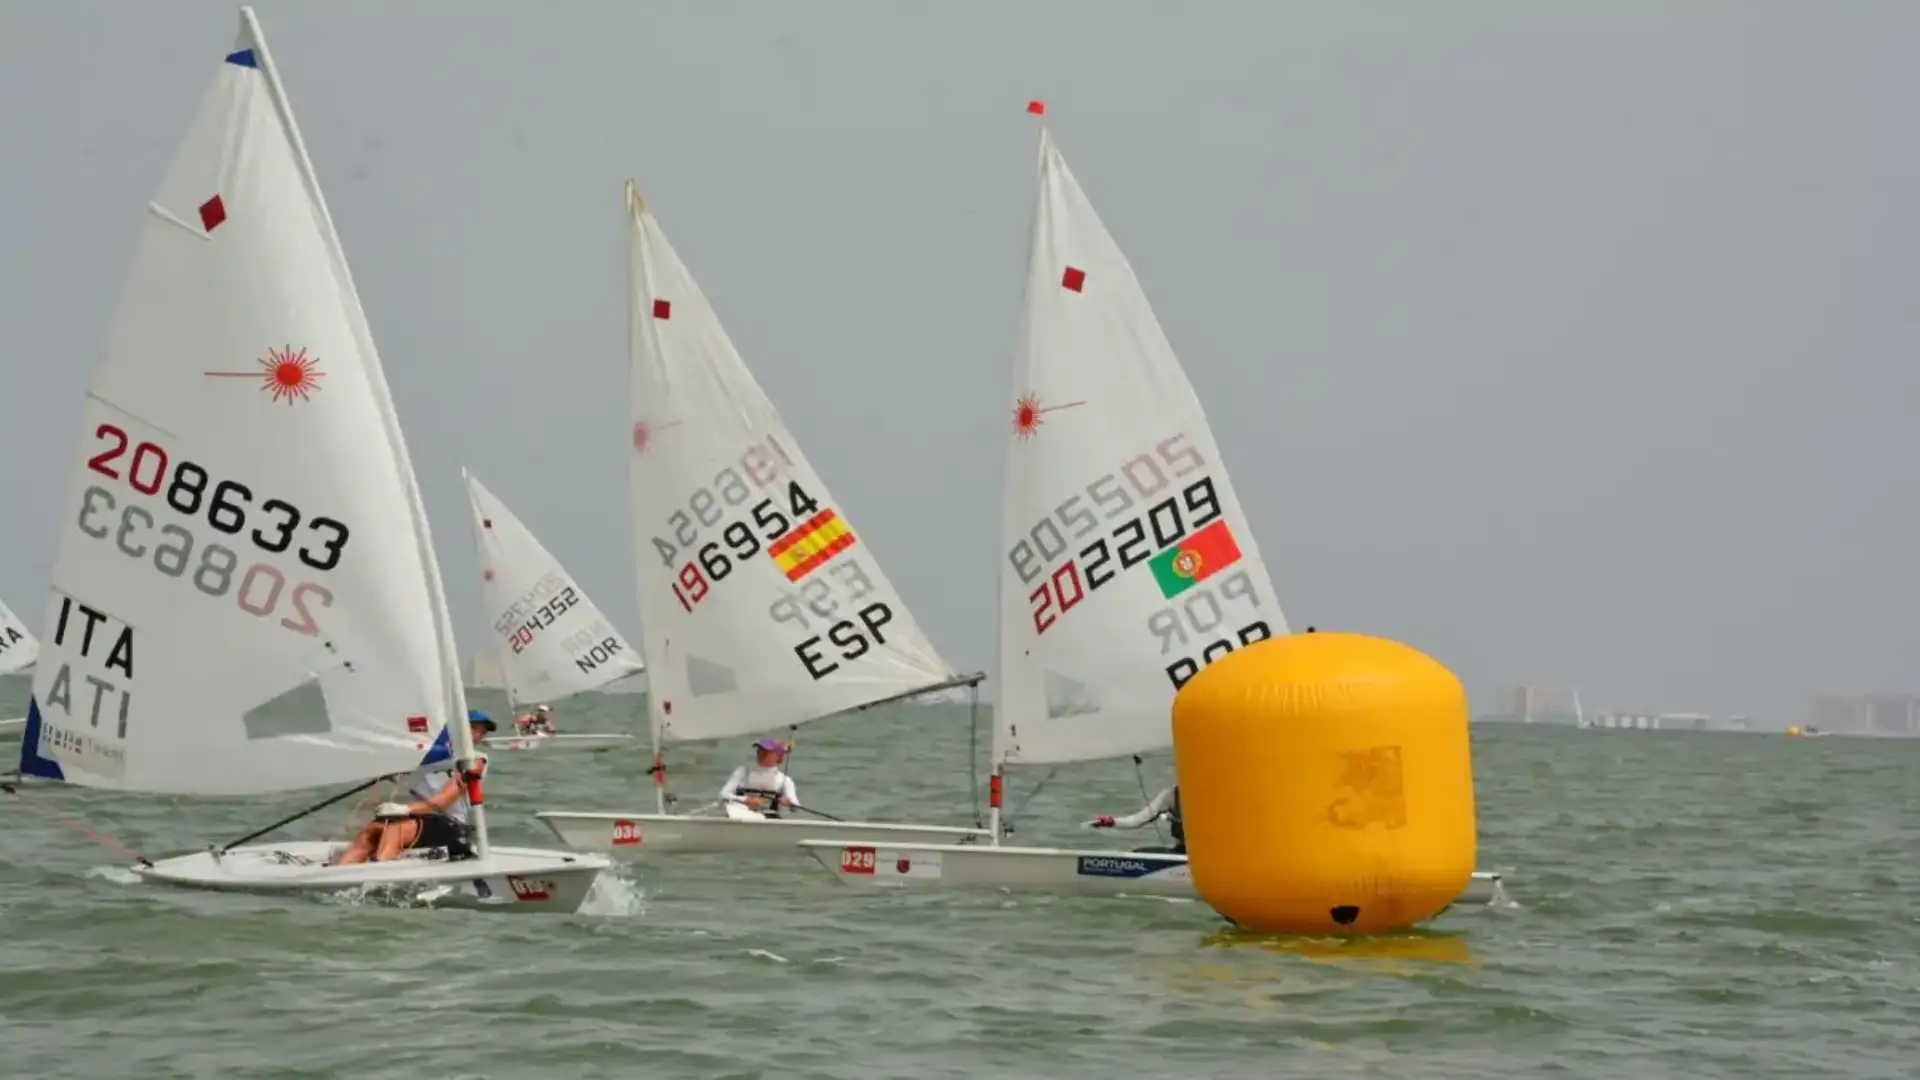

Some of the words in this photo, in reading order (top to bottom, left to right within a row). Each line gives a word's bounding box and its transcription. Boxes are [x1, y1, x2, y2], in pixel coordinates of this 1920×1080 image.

[88, 424, 349, 571] 208633
[672, 480, 817, 613] 196954
[1029, 476, 1221, 635] 202209
[54, 597, 134, 679] ITA
[508, 586, 579, 654] 204352
[576, 637, 622, 674] NOR
[795, 602, 892, 680] ESP
[1084, 857, 1147, 871] PORTUGAL
